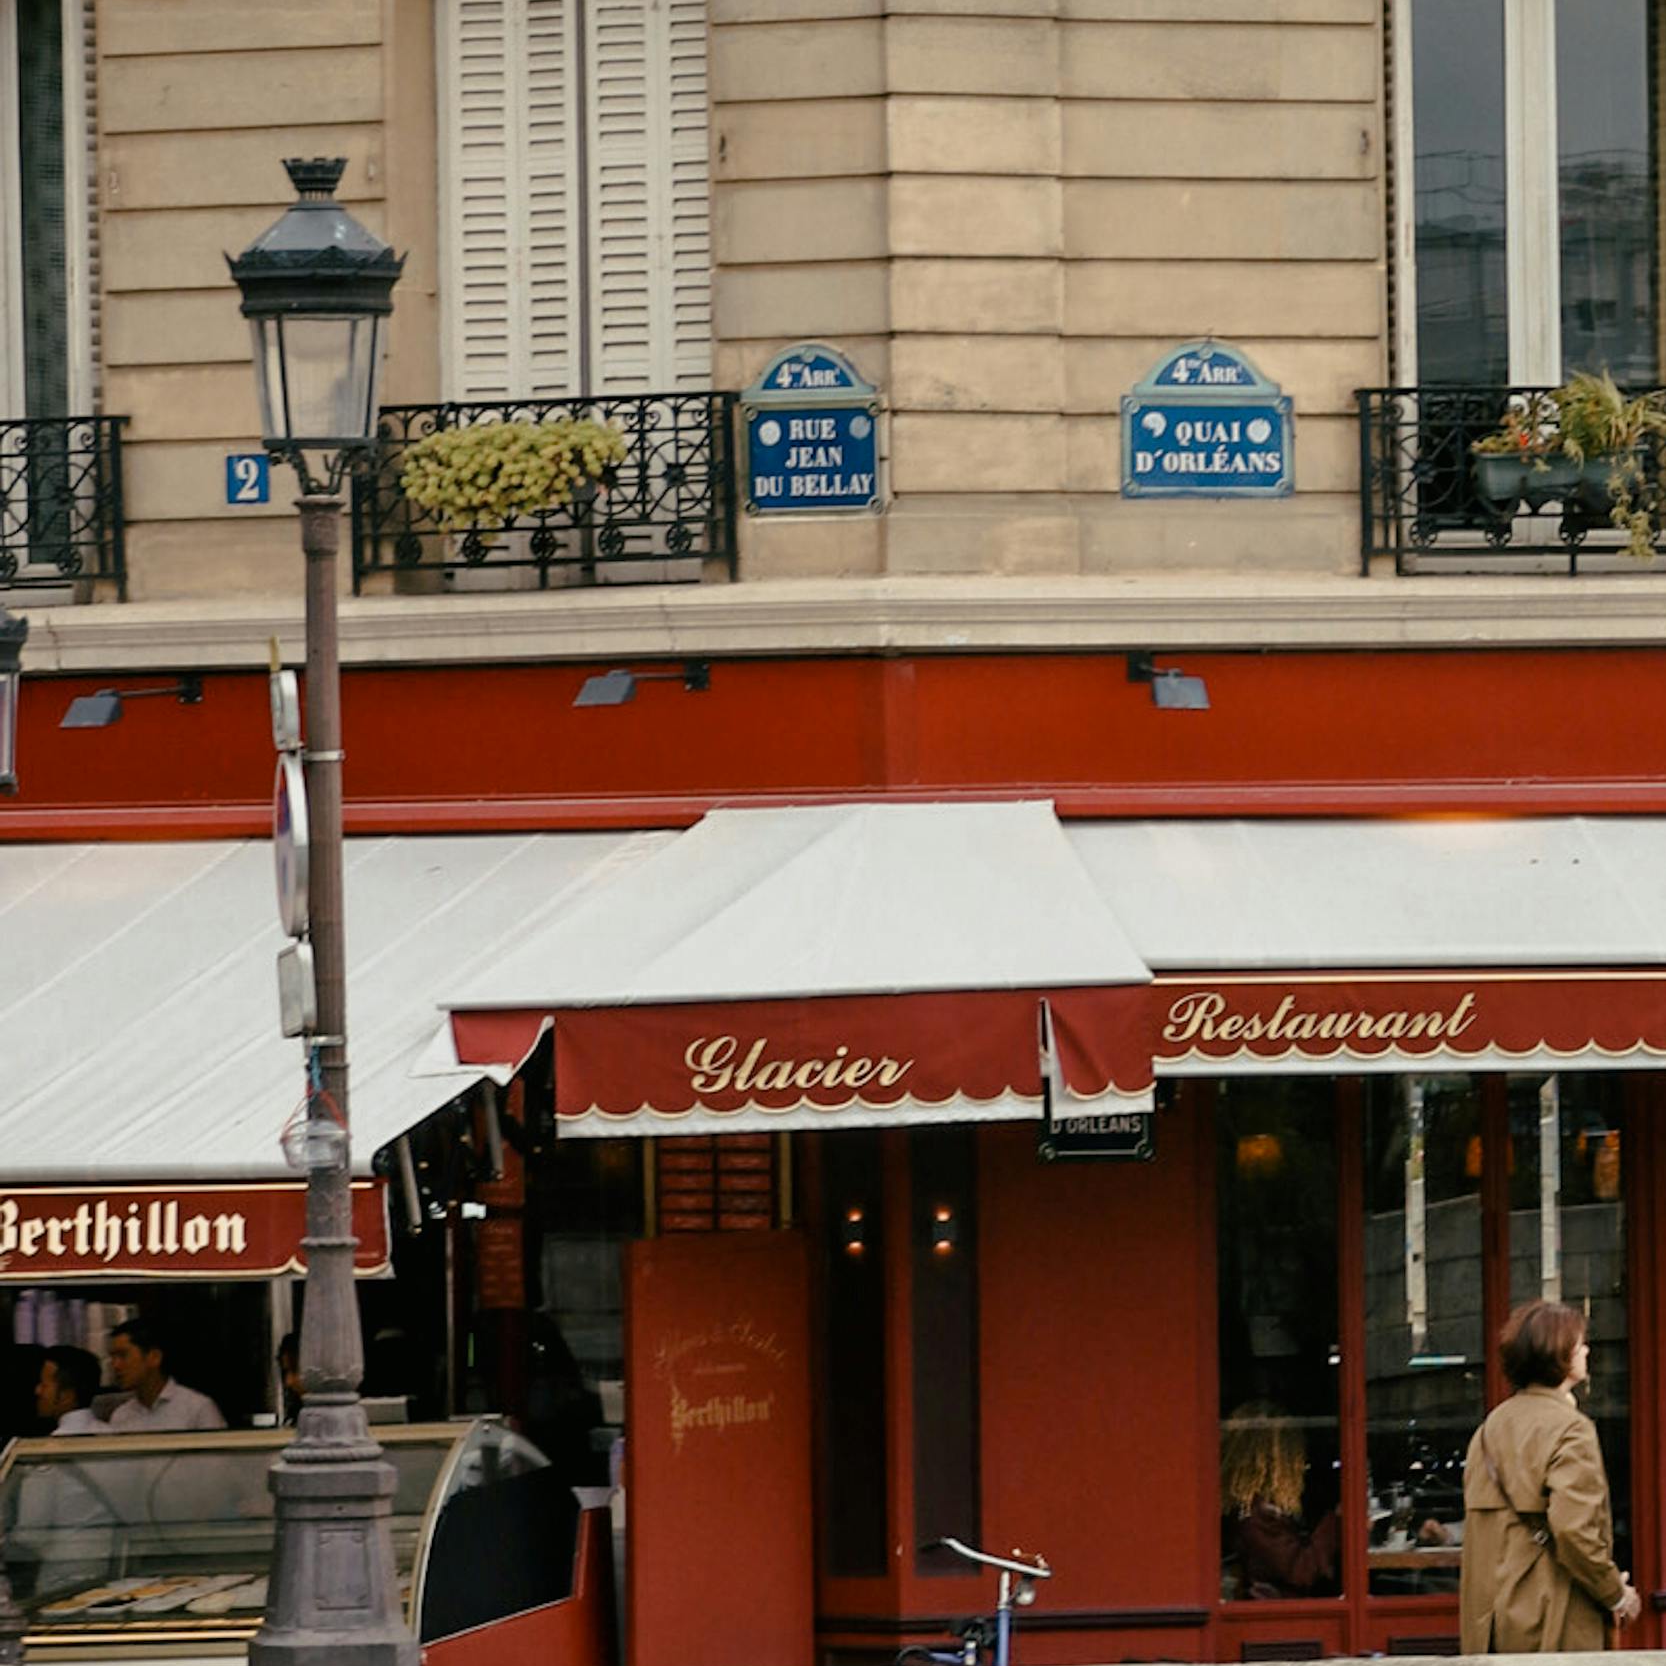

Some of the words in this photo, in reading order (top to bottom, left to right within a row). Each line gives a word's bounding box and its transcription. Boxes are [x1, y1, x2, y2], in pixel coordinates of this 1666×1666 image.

[789, 418, 836, 440] RUE
[1174, 421, 1241, 446] QUAI
[785, 446, 842, 469] JEAN
[234, 458, 259, 500] 2
[754, 476, 784, 497] DU
[790, 473, 873, 496] BELLAY
[1162, 991, 1478, 1042] Restaurant
[684, 1035, 915, 1093] Glacier
[0, 1199, 247, 1263] Berthillon
